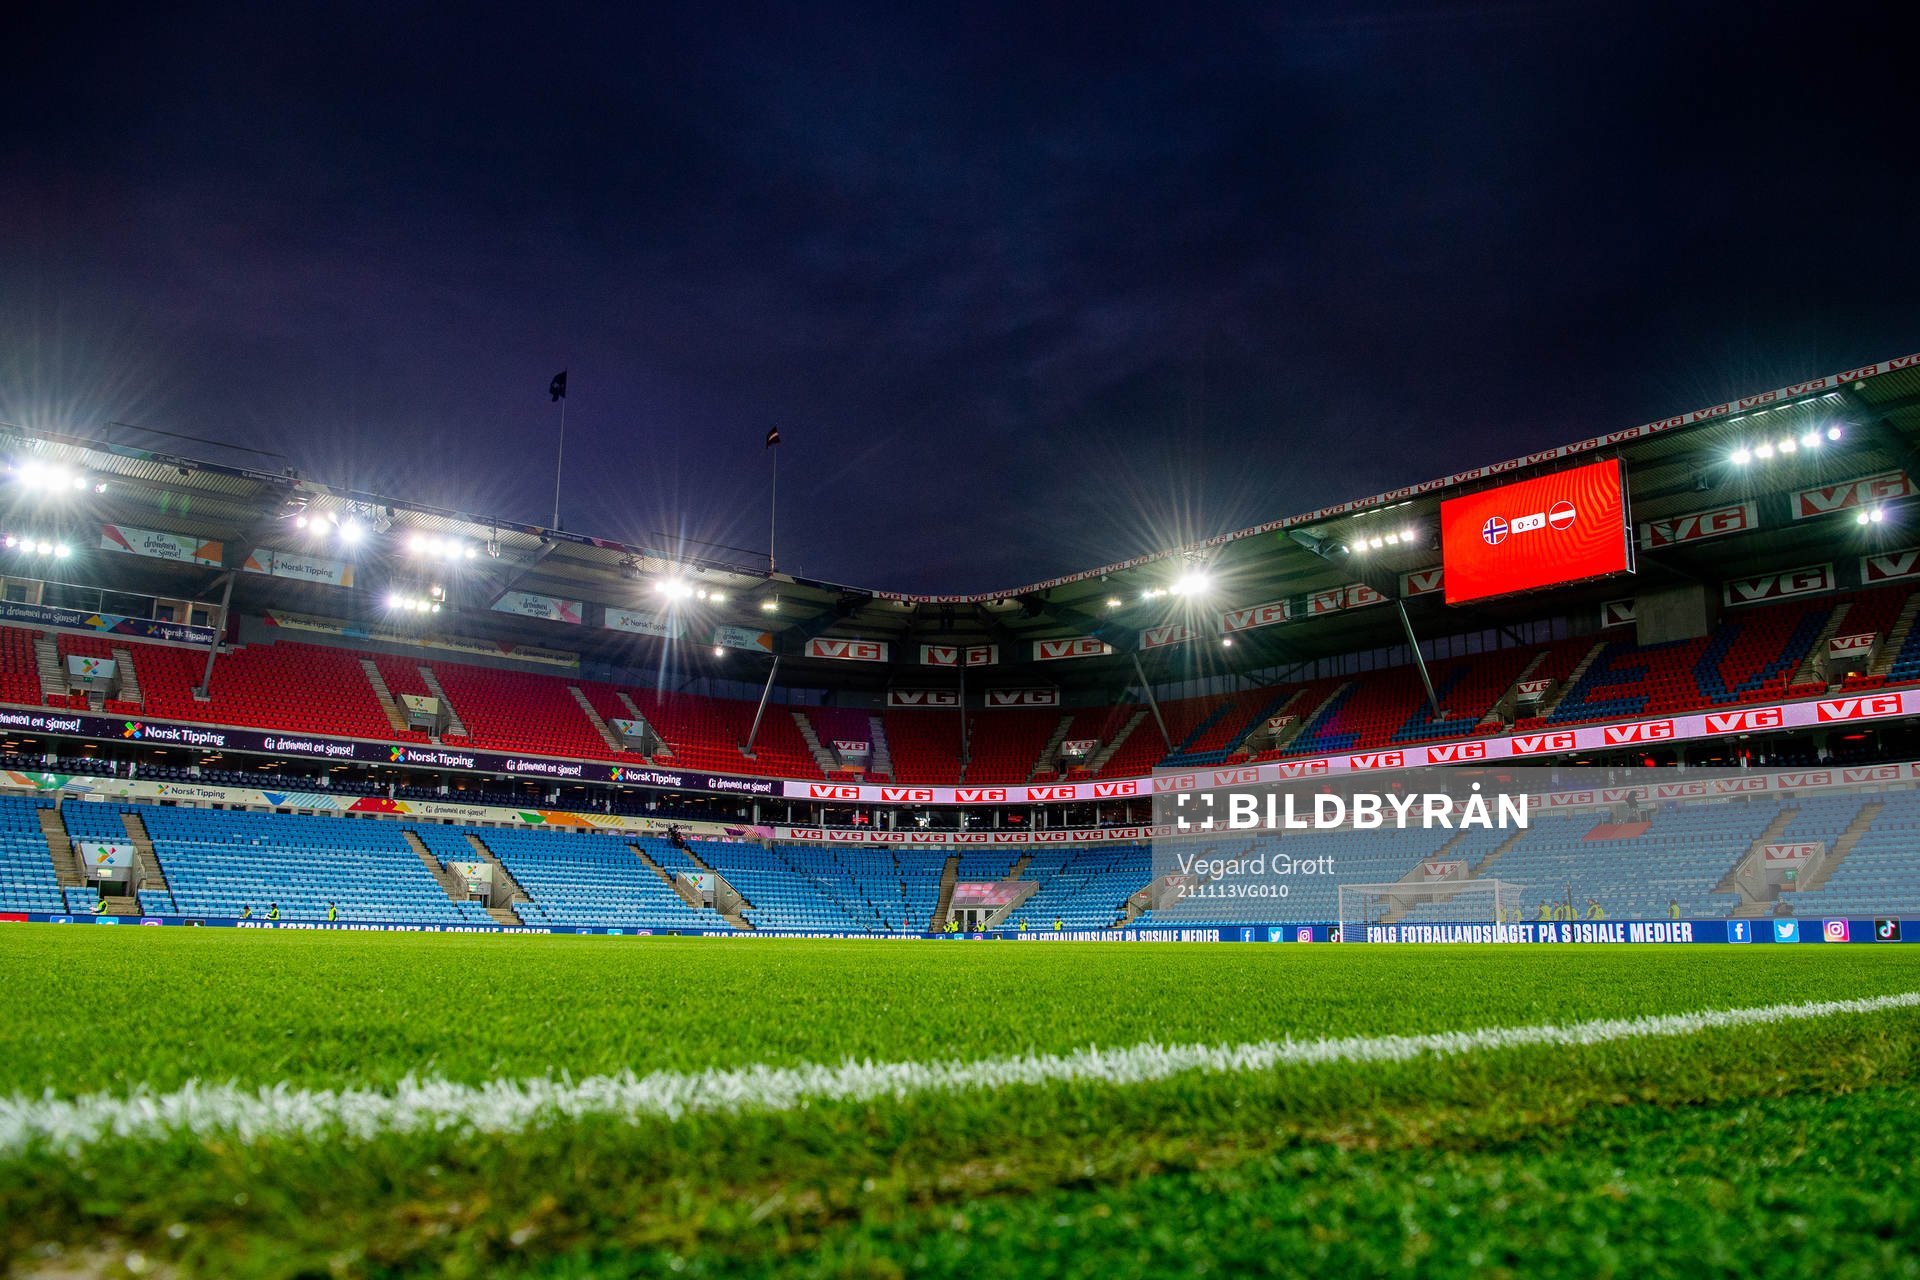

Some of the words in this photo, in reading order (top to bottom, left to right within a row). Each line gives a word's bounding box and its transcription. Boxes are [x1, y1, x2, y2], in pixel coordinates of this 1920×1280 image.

[1803, 473, 1904, 510] VG
[1652, 508, 1742, 542] VG
[281, 562, 304, 572] Norsk
[306, 566, 334, 578] Tipping
[1870, 551, 1920, 576] V
[1730, 566, 1823, 600] VG
[1226, 604, 1281, 629] VG
[161, 628, 184, 638] Norsk
[185, 630, 213, 642] Tipping
[815, 641, 879, 659] VG
[930, 648, 990, 665] VG
[1042, 639, 1101, 657] VG
[893, 689, 958, 705] VG
[992, 689, 1055, 705] VG
[32, 718, 44, 726] en
[46, 718, 80, 732] sjanse!
[145, 726, 180, 740] Norsk
[182, 730, 224, 746] Tipping
[264, 737, 275, 750] Gi
[278, 738, 312, 752] drømmen
[314, 743, 324, 752] en
[326, 744, 354, 757] sjanse!
[812, 786, 858, 799] VG
[884, 788, 932, 801] VG
[956, 789, 1006, 801] VG
[1029, 786, 1075, 800] VG
[1096, 782, 1136, 796] VG
[1154, 775, 1195, 792] VG
[1215, 769, 1259, 785] VG
[1280, 760, 1327, 778] VG
[1352, 752, 1402, 769] VG
[1428, 743, 1486, 762] VG
[1513, 732, 1575, 752] VG
[1606, 722, 1671, 742] VG
[1706, 710, 1780, 732] VG
[1819, 696, 1898, 720] VG
[836, 742, 865, 750] VG
[408, 751, 436, 764] Norsk
[438, 754, 474, 768] Tipping
[506, 760, 516, 770] Gi
[548, 765, 557, 773] en
[558, 765, 582, 776] sjanse!
[626, 770, 650, 782] Norsk
[652, 773, 682, 786] Tipping
[171, 786, 194, 796] Norsk
[195, 788, 226, 799] Tipping
[792, 830, 822, 838] VG
[831, 832, 864, 840] VG
[872, 833, 904, 842] VG
[912, 834, 946, 842] VG
[954, 834, 987, 842] VG
[995, 833, 1028, 842] VG
[1036, 832, 1066, 841] VG
[1074, 831, 1103, 840] VG
[1110, 829, 1138, 838] VG
[1552, 792, 1593, 806] VG
[1780, 772, 1829, 788] VG
[1846, 766, 1898, 782] VG
[1367, 926, 1397, 943] FØLG
[1402, 924, 1534, 943] FOTBALLANDSLAGET
[1538, 922, 1558, 943] PÅ
[1562, 924, 1624, 943] SOSIALE
[1629, 922, 1693, 942] MEDIER
